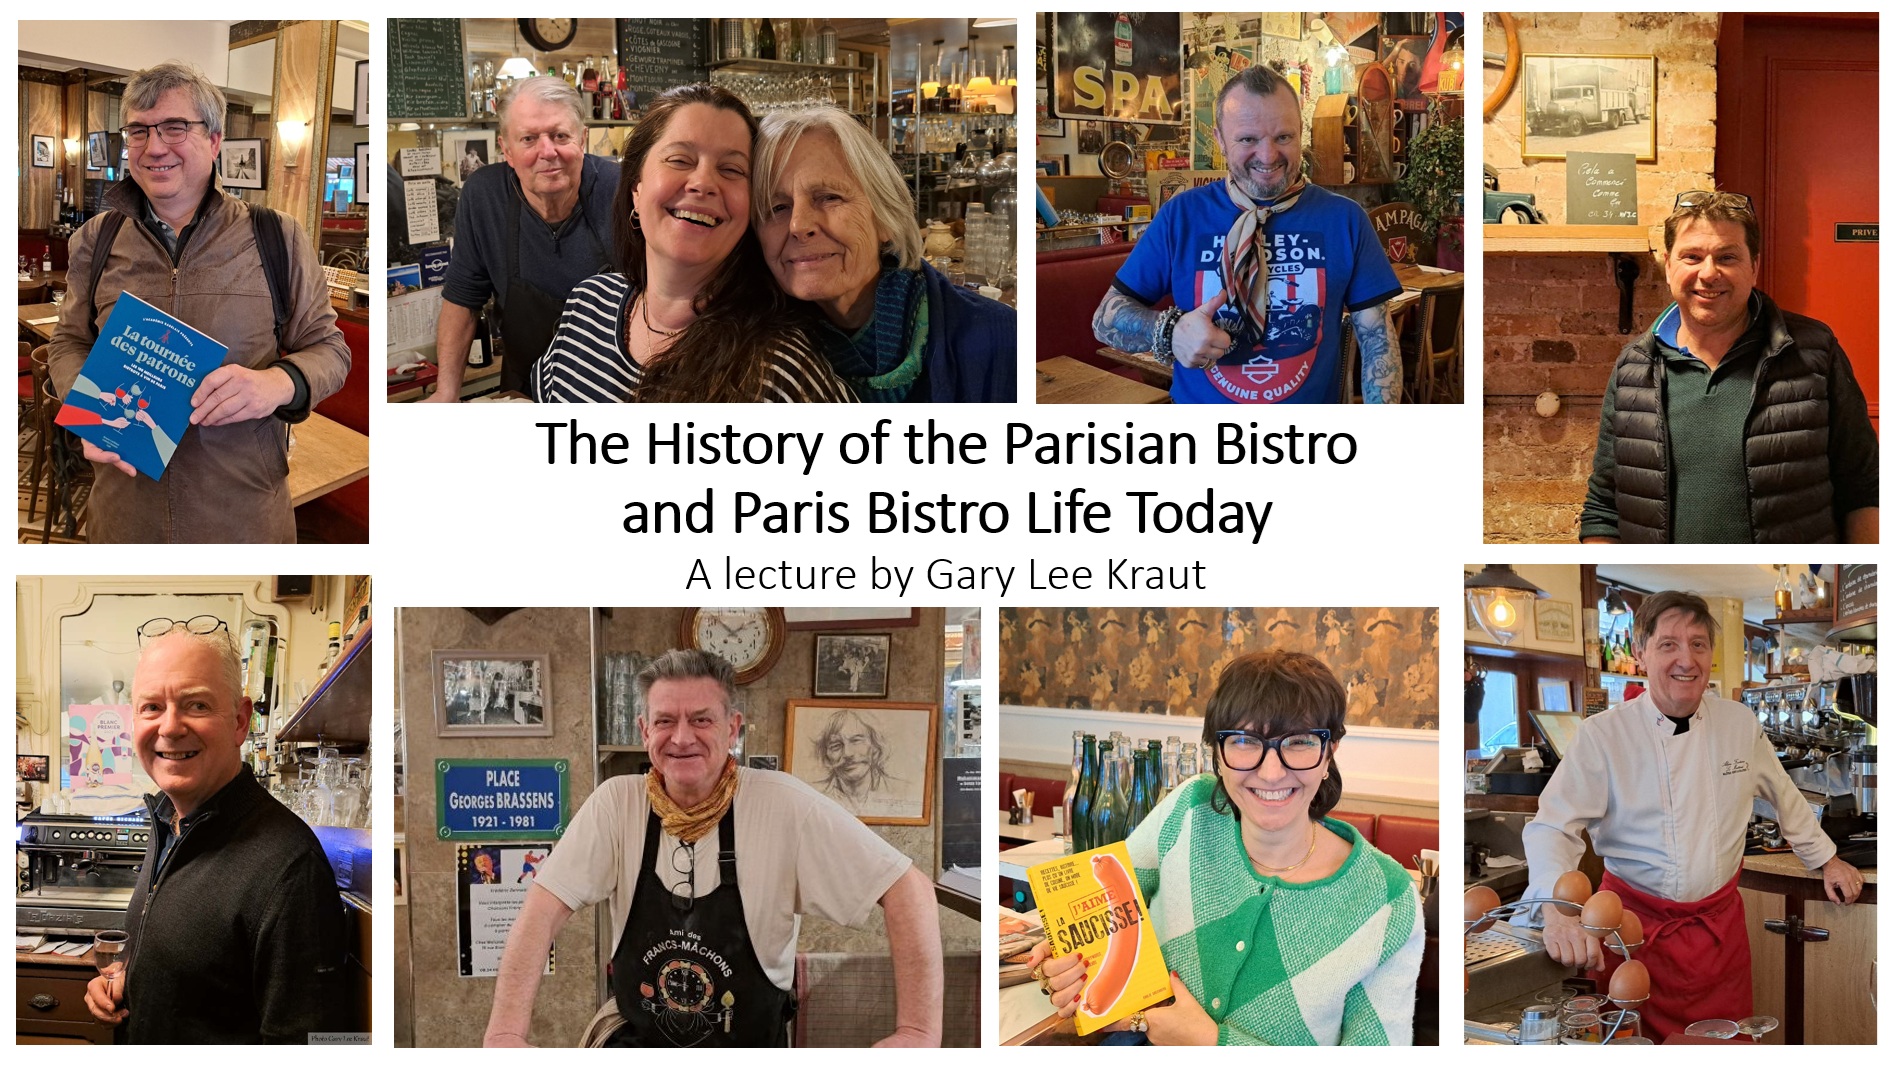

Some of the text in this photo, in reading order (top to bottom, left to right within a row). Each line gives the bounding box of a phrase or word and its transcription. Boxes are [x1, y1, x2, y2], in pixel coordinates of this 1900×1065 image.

[630, 45, 660, 53] VIOGNIER
[630, 64, 669, 73] CHEVERNY
[1073, 65, 1174, 115] SPA
[1213, 234, 1308, 248] HLEY-
[123, 325, 196, 371] La tournée
[110, 336, 196, 388] des patrons
[1210, 361, 1309, 400] GENUINE QUALITY
[486, 770, 520, 787] PLACE
[449, 792, 554, 809] GEORGES BRASSENS
[472, 816, 498, 828] 1921
[509, 816, 535, 828] 1981
[1072, 890, 1117, 916] J'AIME
[1056, 917, 1066, 927] LA
[687, 931, 702, 940] des
[643, 940, 733, 978] FRANCS-MÂCHONS
